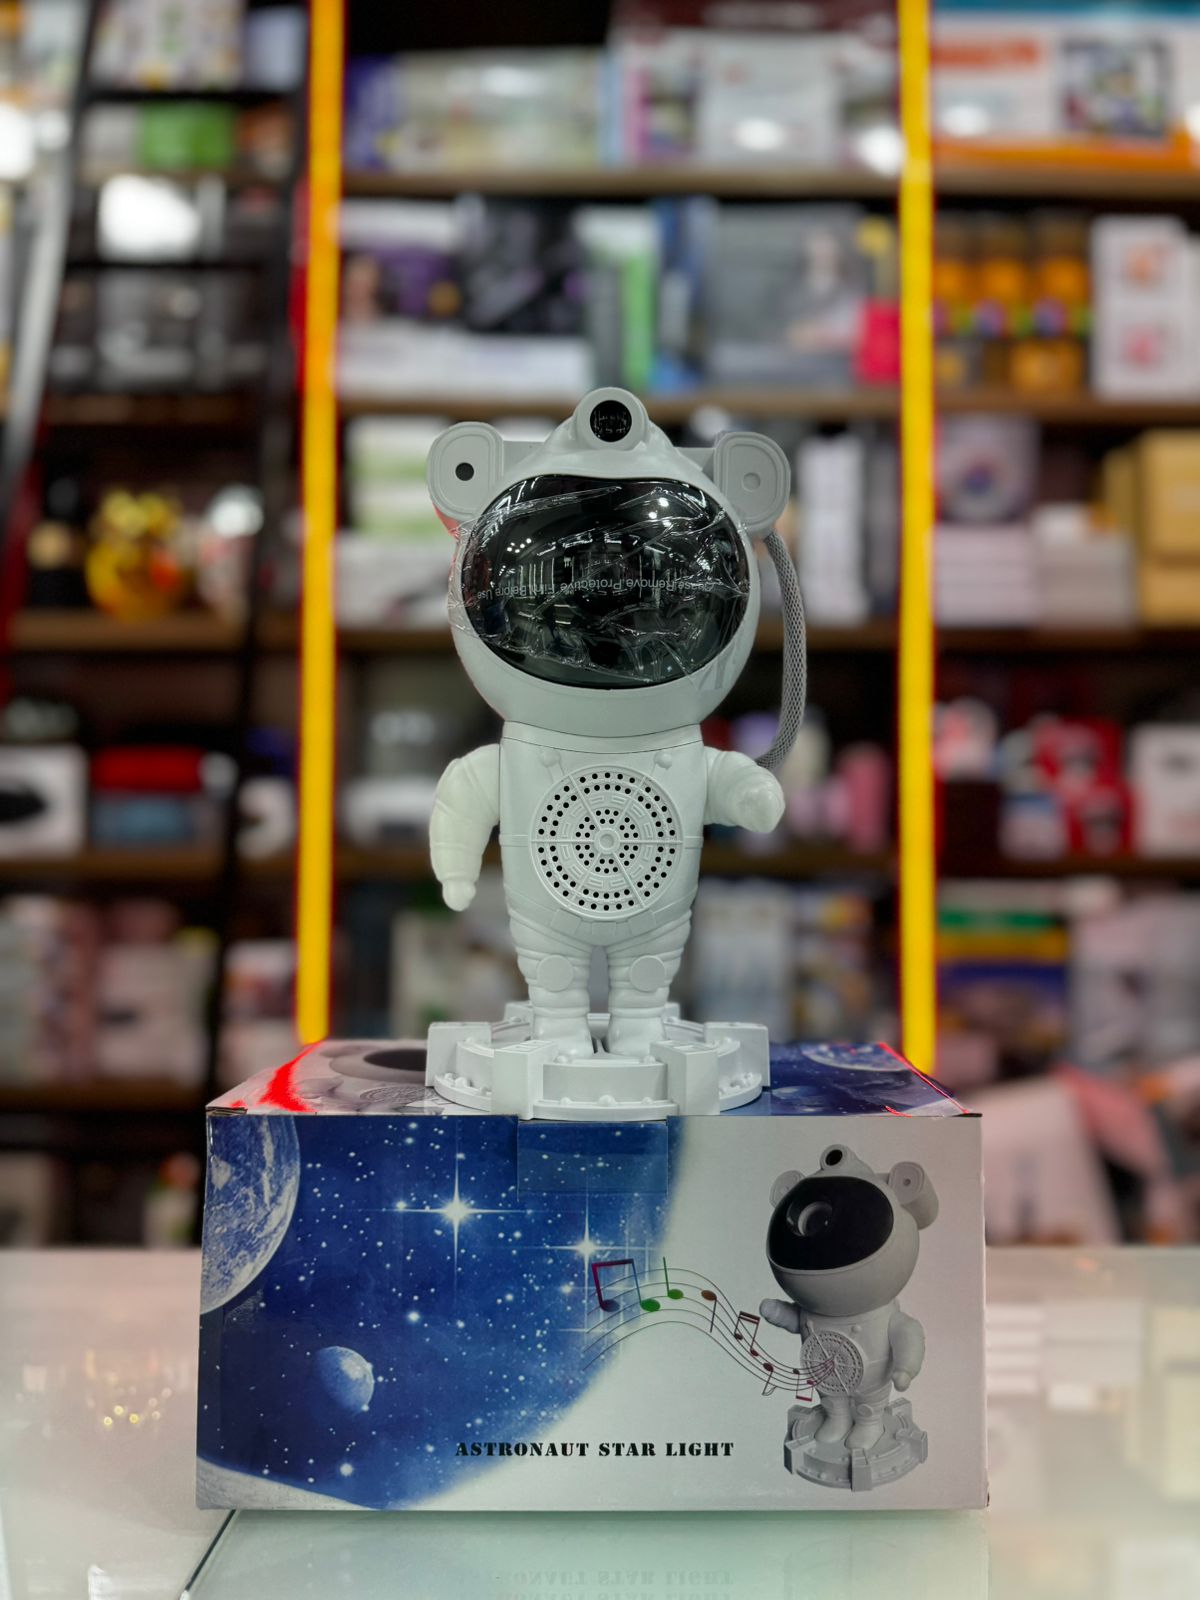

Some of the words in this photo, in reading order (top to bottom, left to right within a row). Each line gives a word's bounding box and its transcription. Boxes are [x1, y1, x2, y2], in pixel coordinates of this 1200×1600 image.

[560, 578, 622, 590] Protective
[626, 578, 674, 591] Remove
[477, 589, 493, 600] Use
[495, 585, 527, 597] Before
[455, 1442, 589, 1456] ASTRONAUT
[599, 1442, 656, 1456] STAR
[666, 1442, 734, 1456] LIGHT
